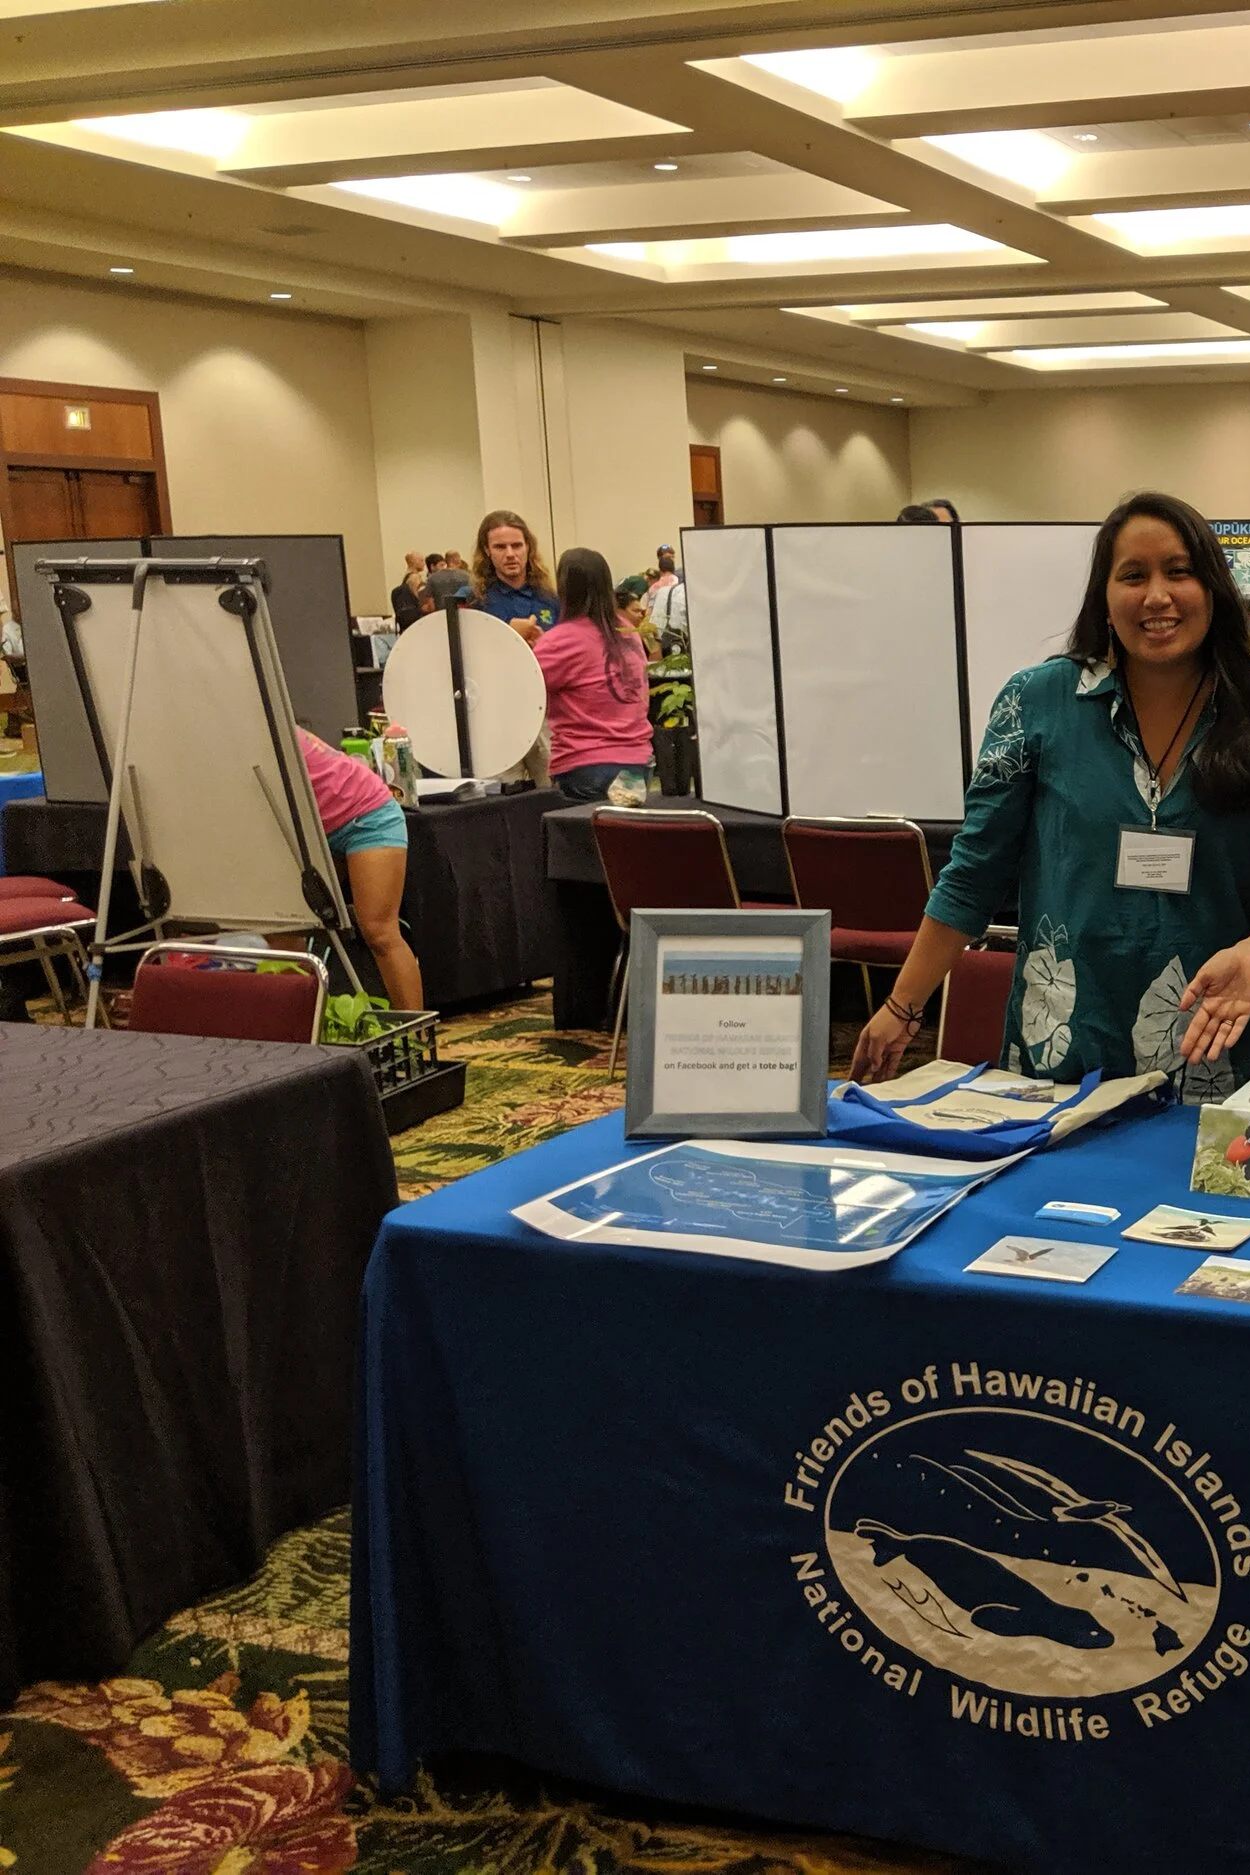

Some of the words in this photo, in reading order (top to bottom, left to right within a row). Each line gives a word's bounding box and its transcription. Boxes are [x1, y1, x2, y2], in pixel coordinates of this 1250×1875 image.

[719, 1020, 746, 1028] Follow
[664, 1062, 675, 1070] on
[677, 1061, 717, 1070] Facebook
[719, 1061, 735, 1070] and
[736, 1062, 750, 1072] get
[759, 1062, 777, 1070] tote
[779, 1061, 798, 1072] bag!
[784, 1391, 891, 1511] Friends
[902, 1365, 939, 1404] of
[951, 1361, 1146, 1438] Hawaiian
[790, 1552, 923, 1697] National
[951, 1684, 1110, 1741] Wildlife
